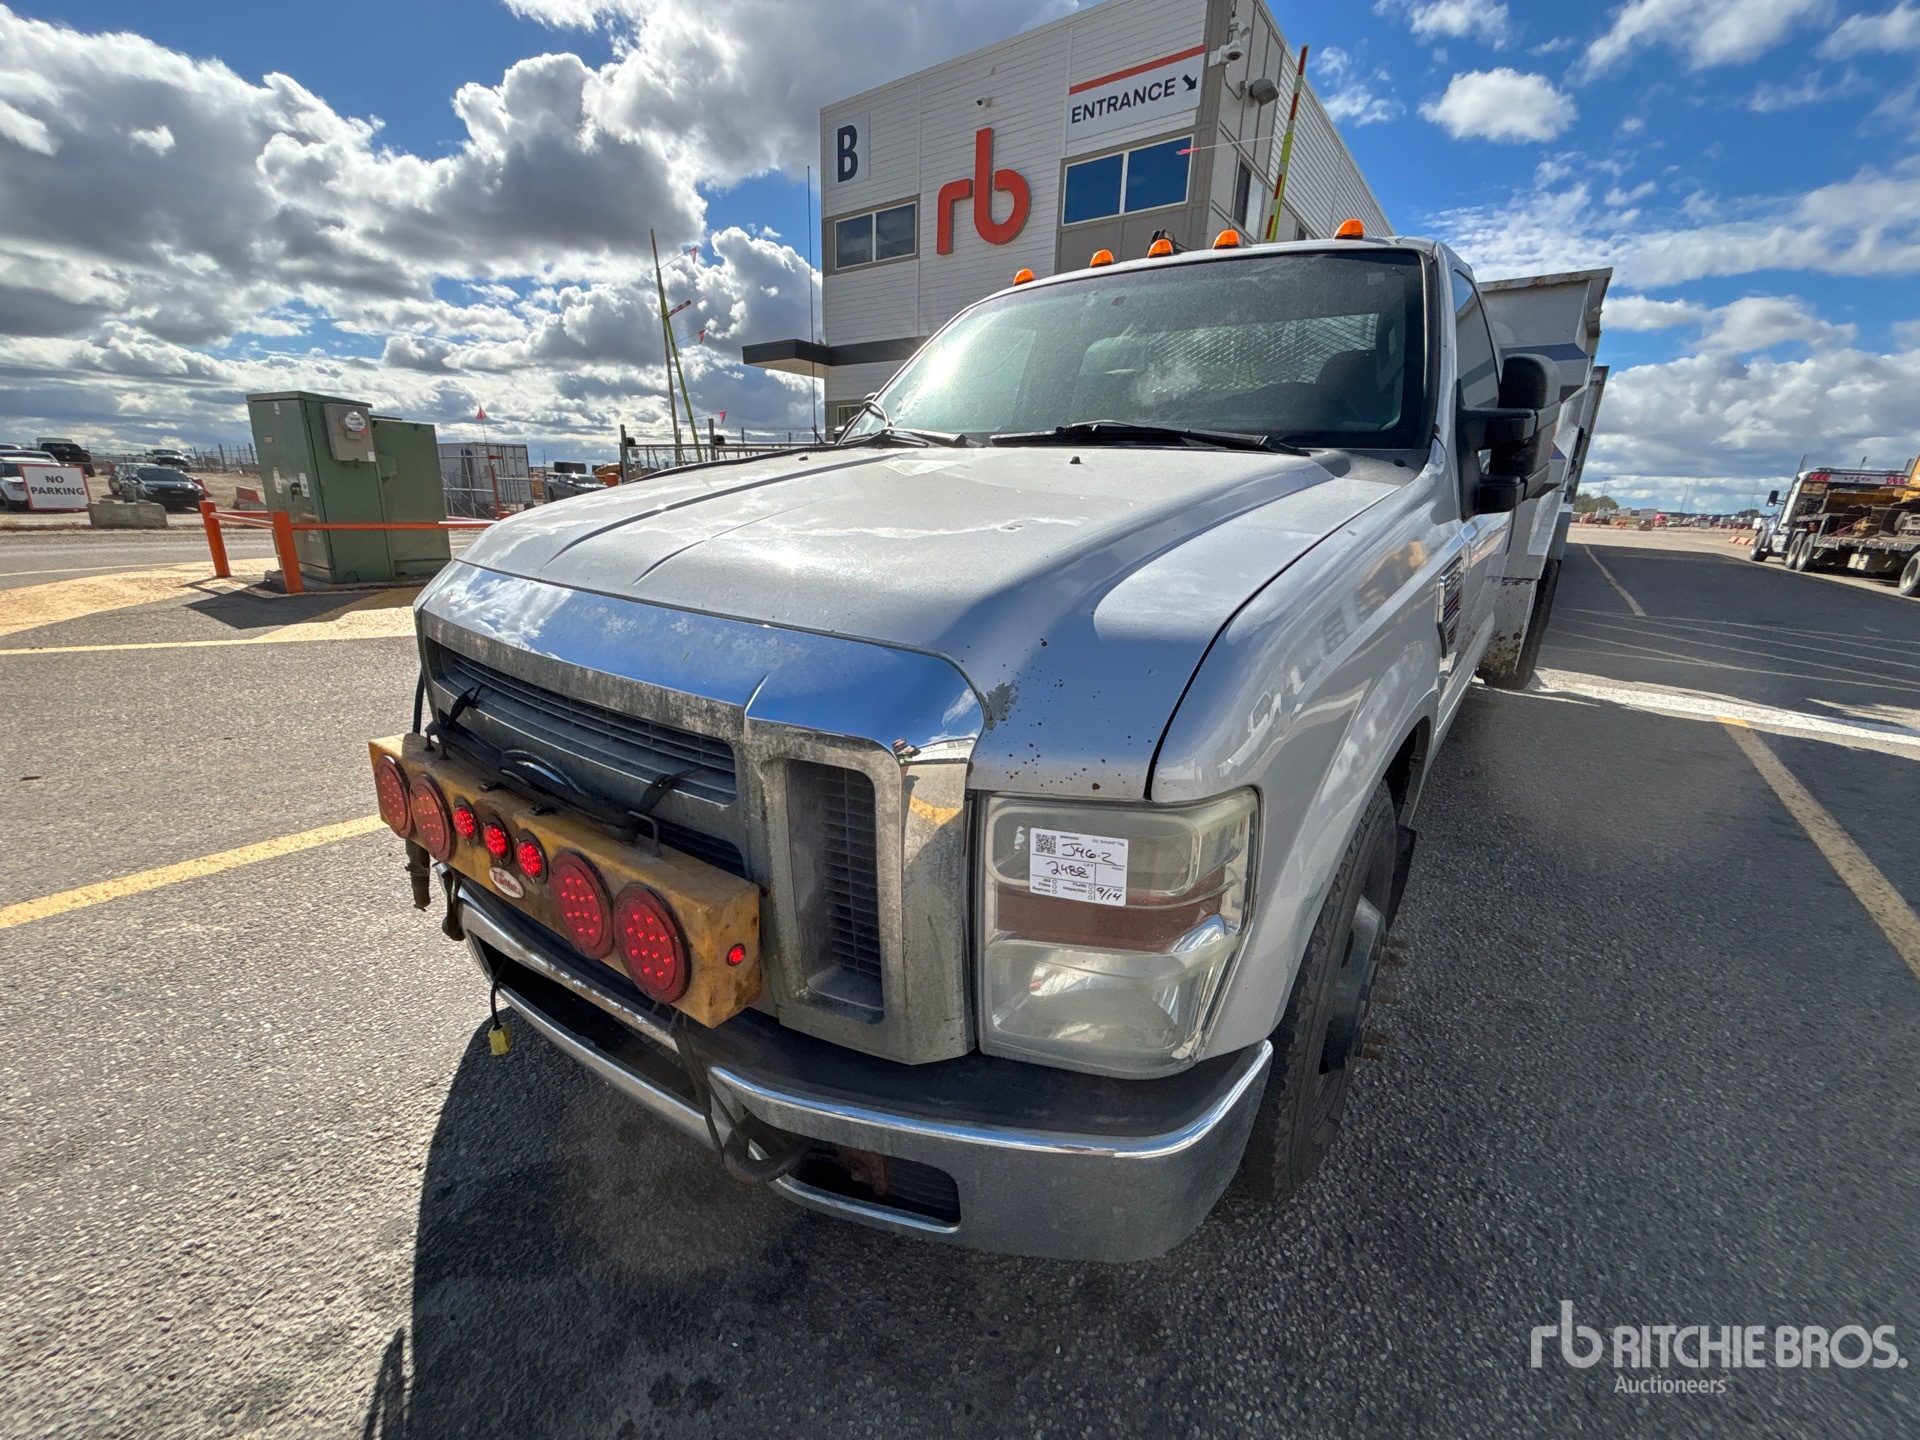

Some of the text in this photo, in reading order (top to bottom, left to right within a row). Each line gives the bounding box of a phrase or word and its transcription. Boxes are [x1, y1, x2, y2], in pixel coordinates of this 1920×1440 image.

[1070, 76, 1176, 125] ENTRANCE
[836, 124, 859, 183] B
[936, 127, 1032, 256] rb
[45, 475, 64, 484] NO
[30, 487, 85, 495] PARKING
[1046, 861, 1089, 878] 2488
[1096, 887, 1122, 900] 9/14
